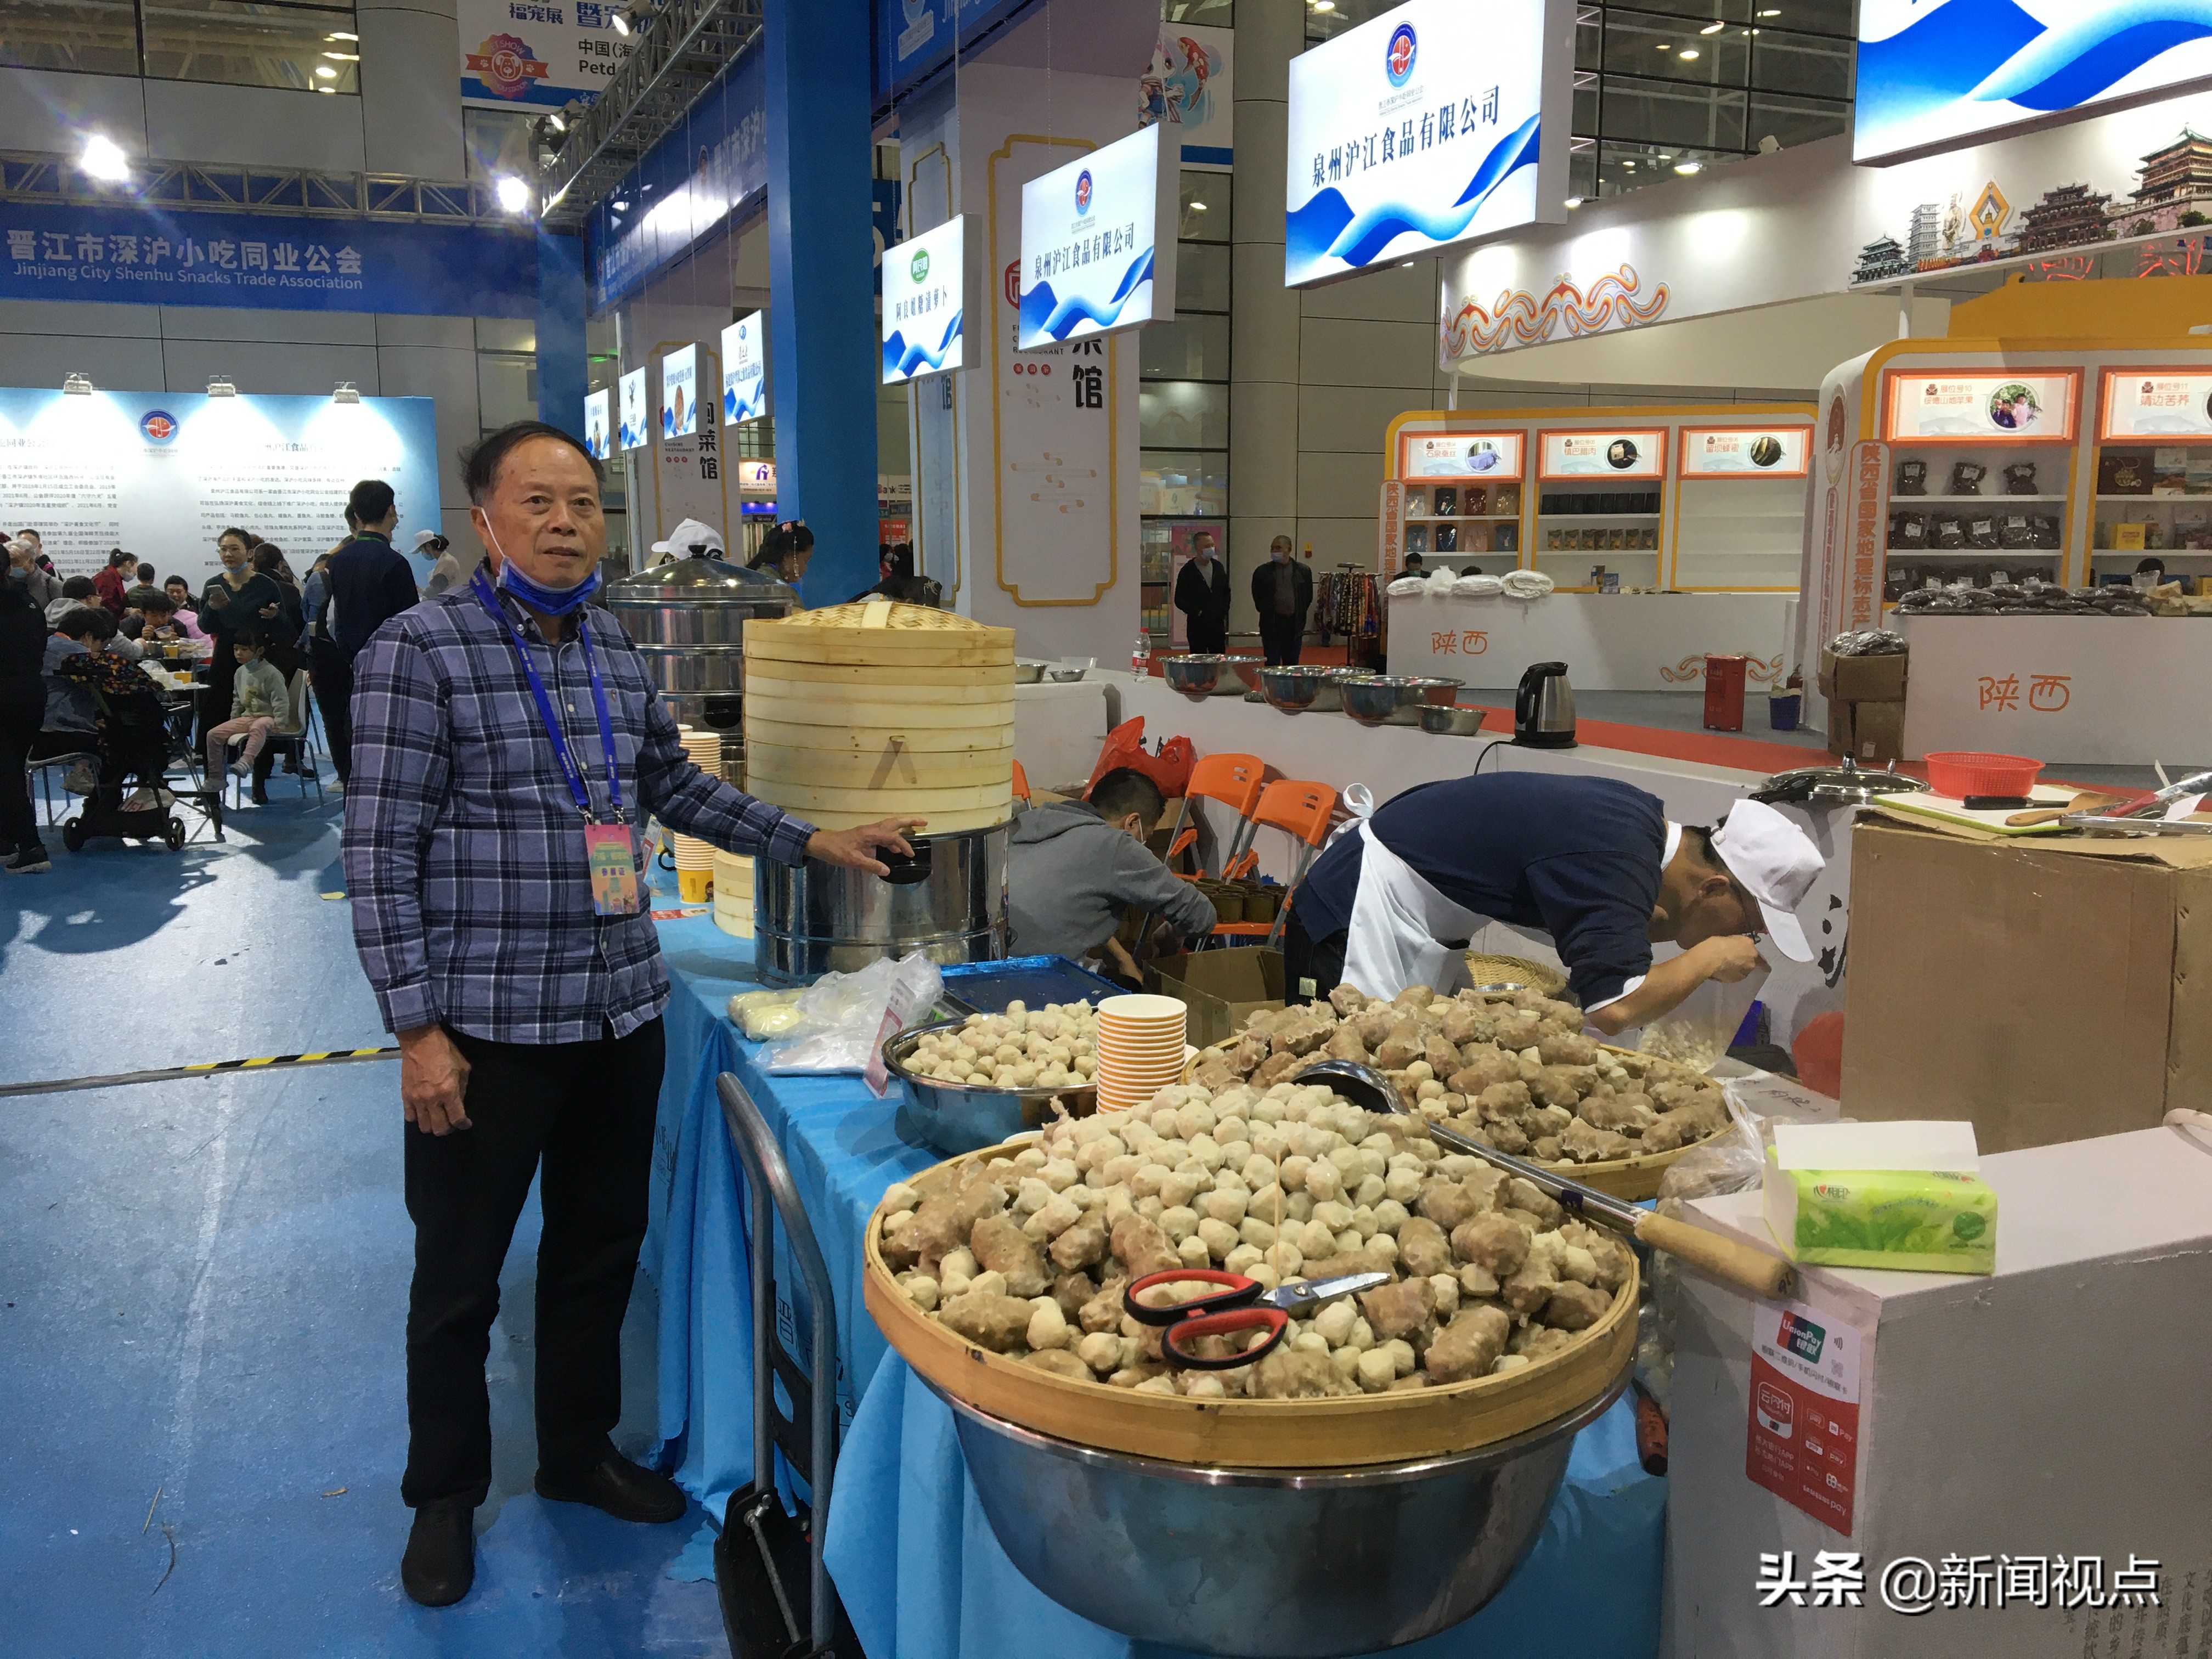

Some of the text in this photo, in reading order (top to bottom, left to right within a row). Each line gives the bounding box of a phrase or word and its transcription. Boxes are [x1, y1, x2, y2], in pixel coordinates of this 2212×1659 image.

[510, 3, 563, 24] 福宠展
[500, 40, 525, 54] SHOW
[1312, 84, 1500, 188] 泉州沪江食品有限公司
[7, 230, 362, 274] 晋江市深沪小吃同业公会
[1035, 222, 1135, 280] 泉州沪江食品有限公司
[14, 262, 363, 289] Jinjiang City Shenhu Snacks Trade Association
[1013, 347, 1064, 355] RRANT
[2140, 394, 2190, 407] 靖边苦荞
[1564, 448, 1596, 456] 镇巴腊肉
[1431, 630, 1488, 656] 陕西
[1978, 674, 2072, 712] 陕西
[1783, 1319, 1821, 1348] UnionPay
[1797, 1338, 1819, 1356] 银联
[1760, 1390, 1791, 1414] 云闪付
